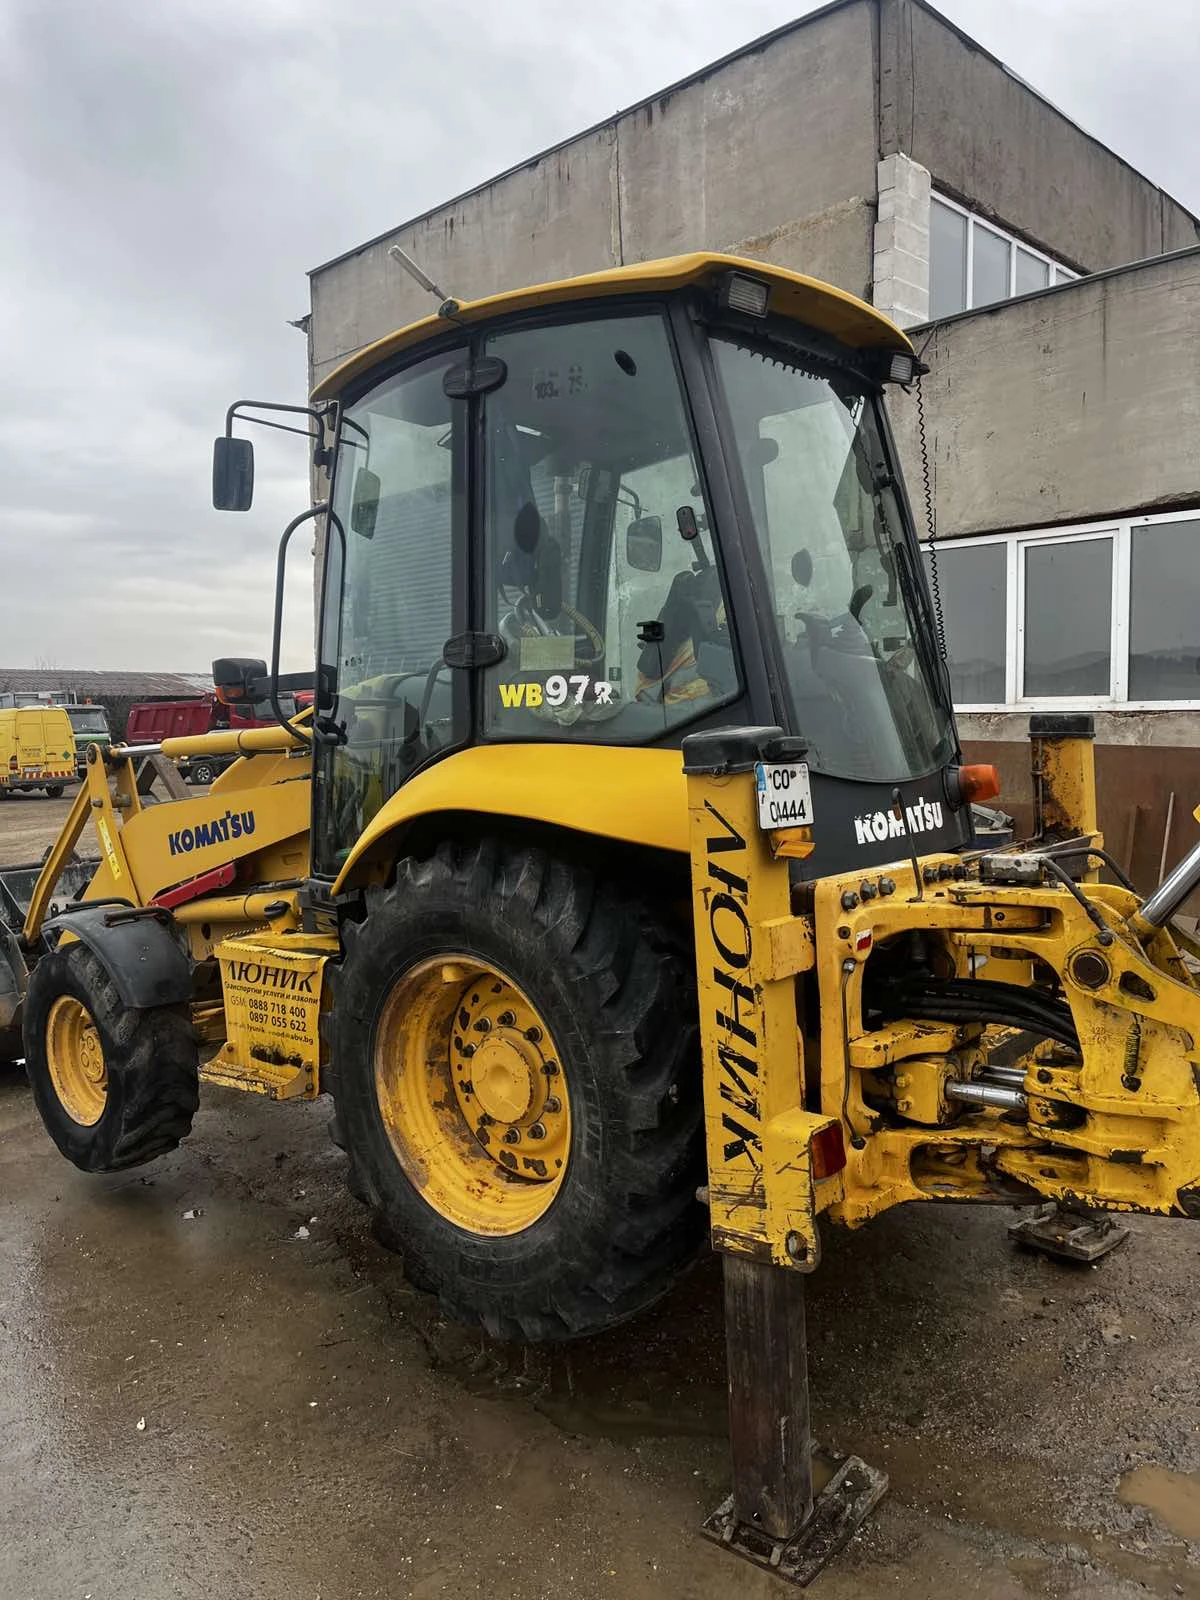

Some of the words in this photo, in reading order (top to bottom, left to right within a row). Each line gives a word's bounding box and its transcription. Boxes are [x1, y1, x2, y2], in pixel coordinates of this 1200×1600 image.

[168, 811, 256, 856] KOMATSU
[227, 960, 318, 993] ЛЮНИК
[704, 800, 763, 1169] ЛЮНИК
[248, 998, 268, 1012] 0888
[271, 1002, 287, 1015] 718
[289, 1005, 306, 1019] 400
[249, 1011, 268, 1025] 0897
[271, 1015, 287, 1029] 055
[290, 1019, 307, 1032] 622
